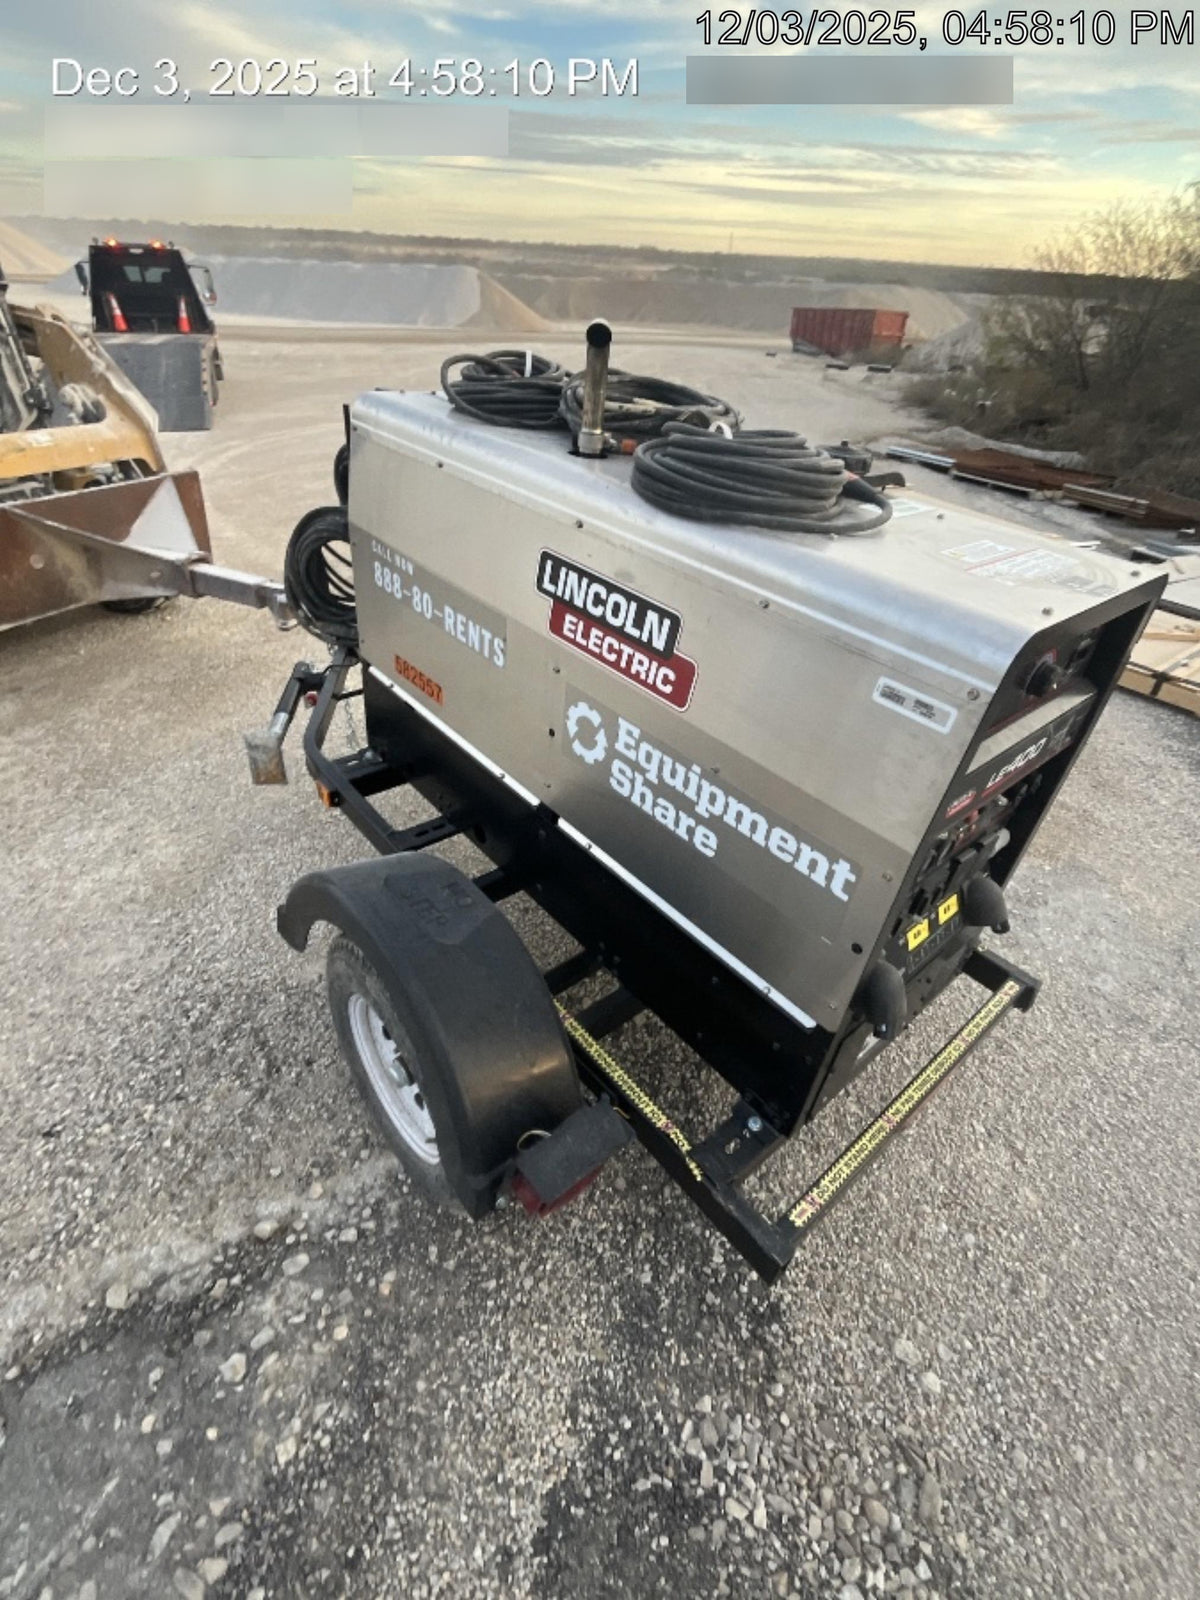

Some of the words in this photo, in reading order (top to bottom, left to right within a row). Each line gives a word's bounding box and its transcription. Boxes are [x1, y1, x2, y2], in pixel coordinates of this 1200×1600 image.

[373, 560, 506, 668] 888-80-RENTS
[541, 559, 671, 653] LINCOLN
[562, 612, 678, 695] ELECTRIC
[609, 758, 719, 860] Share
[614, 716, 857, 903] Equipment
[815, 1182, 831, 1199] DO
[826, 1166, 846, 1186] NOT
[842, 1142, 869, 1169] STAND
